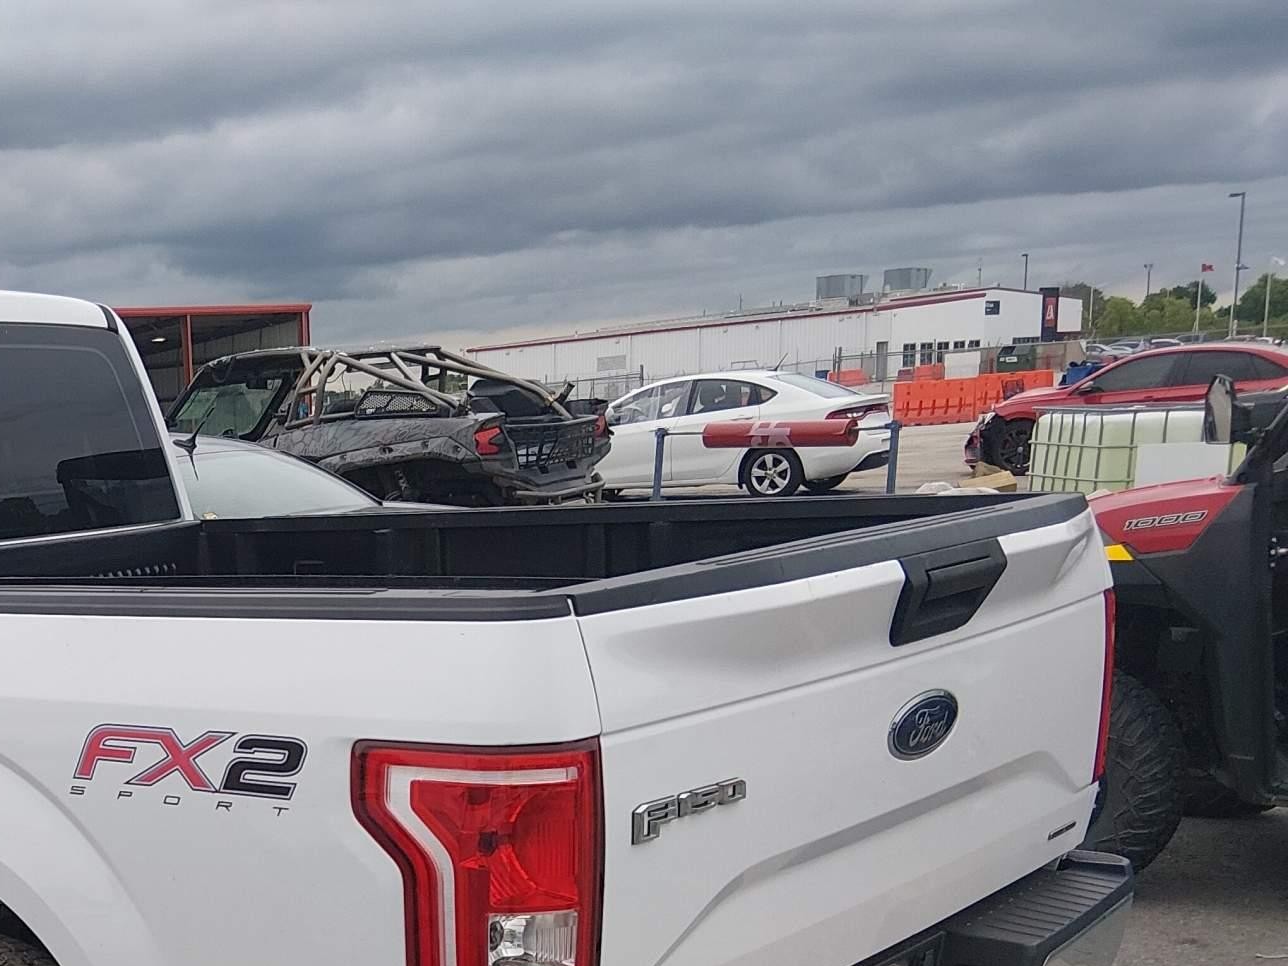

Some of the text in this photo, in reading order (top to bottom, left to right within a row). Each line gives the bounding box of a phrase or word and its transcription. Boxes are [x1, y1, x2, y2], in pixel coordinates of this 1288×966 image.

[1123, 510, 1208, 530] 1000
[73, 723, 308, 800] FX2
[69, 784, 289, 817] SPORT
